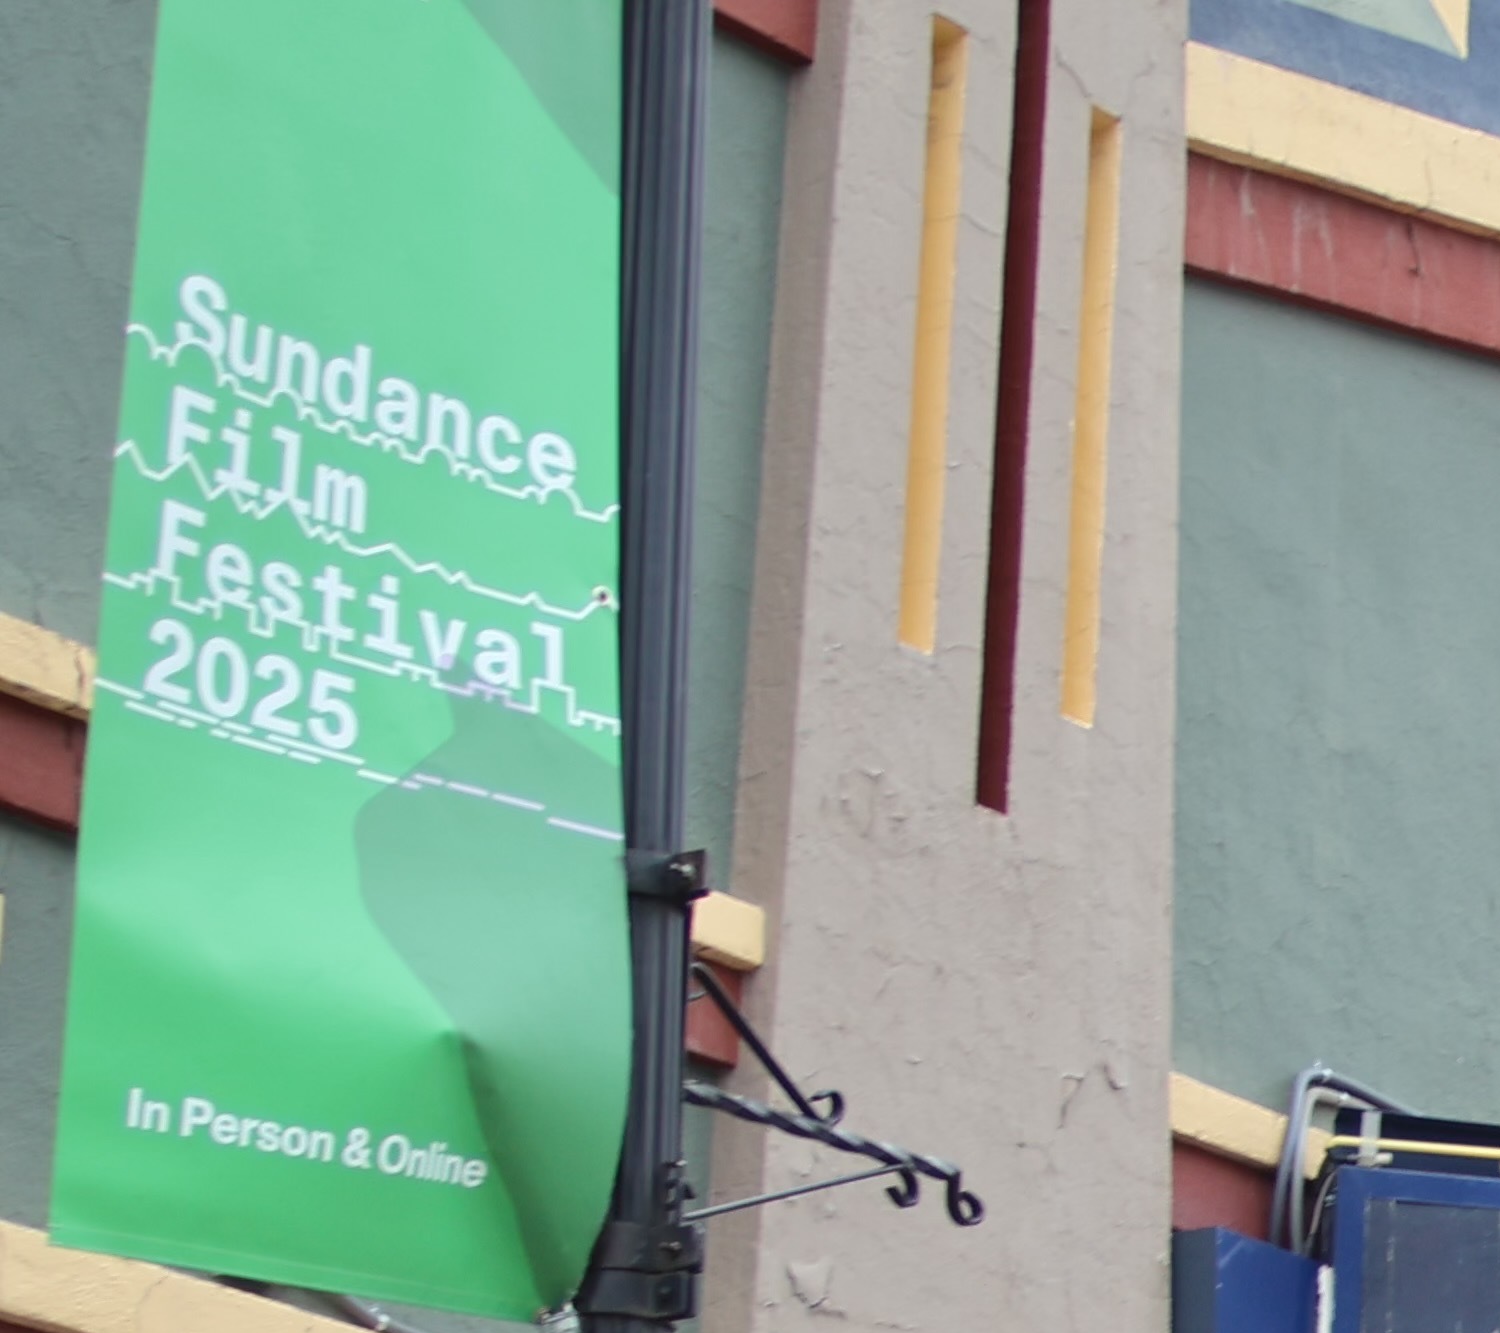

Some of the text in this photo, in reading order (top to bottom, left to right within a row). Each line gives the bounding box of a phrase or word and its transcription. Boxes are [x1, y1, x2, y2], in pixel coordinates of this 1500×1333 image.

[174, 274, 577, 492] Sundance
[166, 384, 367, 534] Film
[155, 500, 564, 690] Festival
[143, 618, 358, 750] 2025
[126, 1087, 489, 1188] In Person & Online
